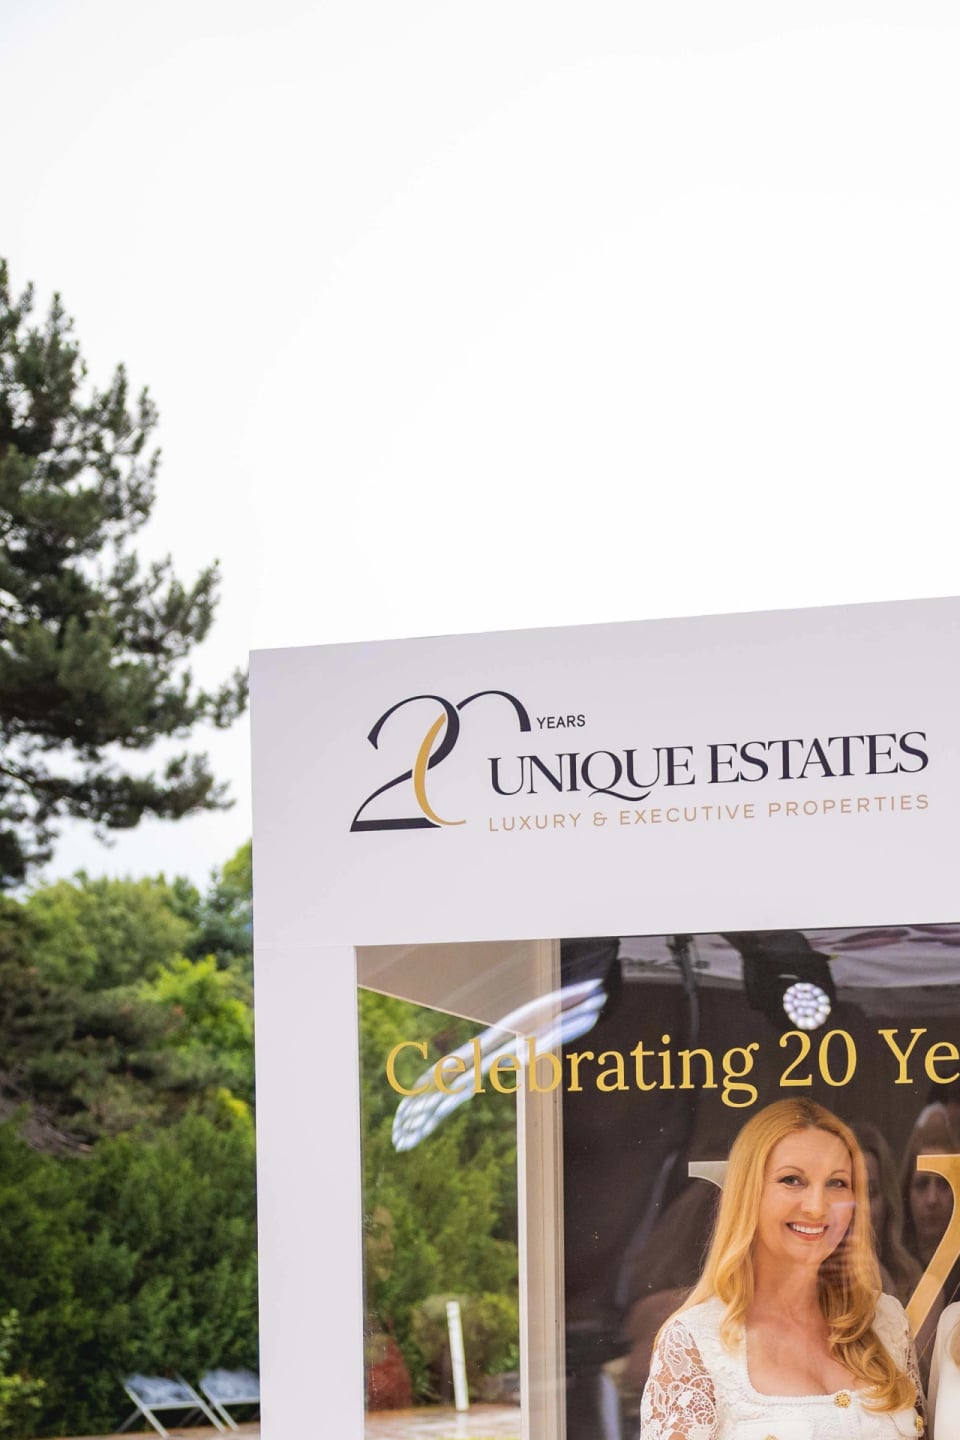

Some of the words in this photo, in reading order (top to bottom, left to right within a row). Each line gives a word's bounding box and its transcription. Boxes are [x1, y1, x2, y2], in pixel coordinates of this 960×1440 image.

[536, 714, 586, 729] YEARS
[488, 745, 696, 802] UNIQUE
[707, 731, 929, 784] ESTATES
[488, 812, 581, 832] LUXURY
[592, 811, 608, 828] &
[618, 803, 755, 826] EXECUTIVE
[767, 794, 929, 816] PROPERTIES
[386, 1034, 760, 1108] Celebrating
[779, 1029, 857, 1087] 20
